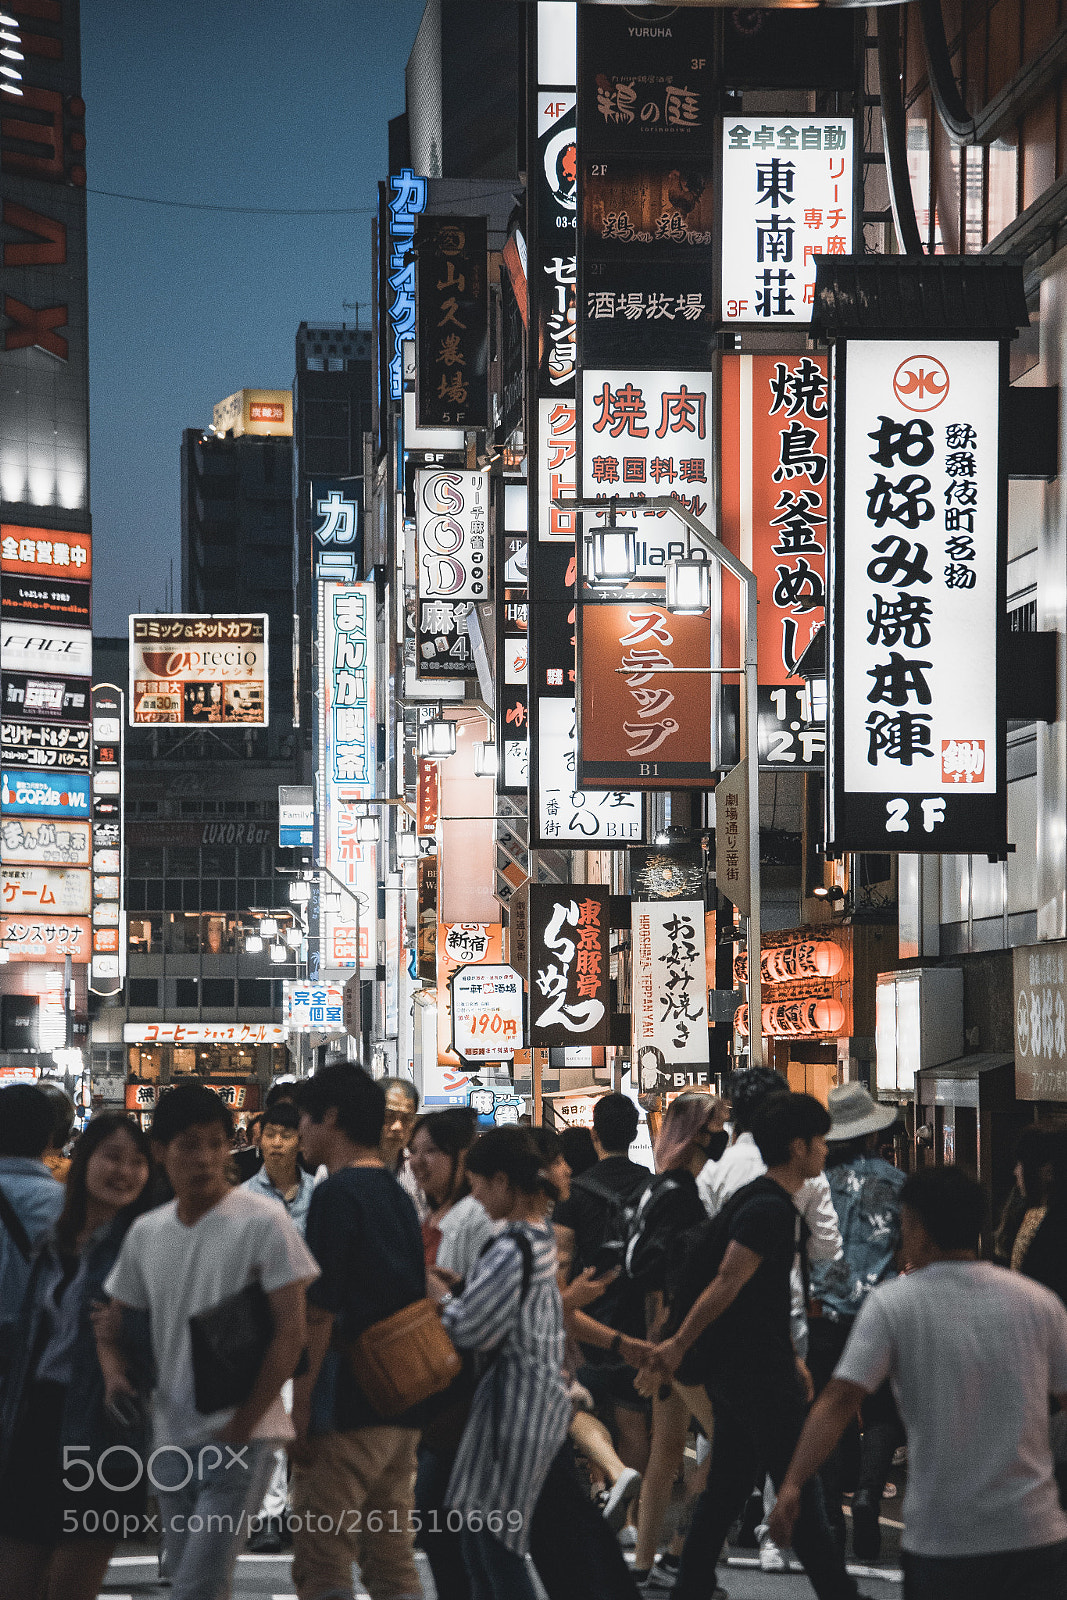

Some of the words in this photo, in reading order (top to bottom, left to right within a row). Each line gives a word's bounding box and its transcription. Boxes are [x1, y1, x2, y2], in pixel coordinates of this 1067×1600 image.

[628, 27, 672, 37] YURUHA
[691, 58, 706, 70] 3F
[544, 102, 566, 118] 4F
[728, 124, 847, 150] 全卓全自動
[591, 164, 608, 176] 2F
[755, 157, 796, 318] 東南荘
[587, 292, 706, 321] 酒場牧場
[726, 300, 748, 318] 3F
[441, 412, 467, 424] 5F
[591, 381, 706, 440] 焼肉
[547, 403, 576, 536] クアトロ
[592, 456, 707, 485] 韓国料理
[768, 357, 827, 678] 焼鳥釜めし
[943, 423, 978, 591] 歌舞伎町名物
[1, 536, 87, 568] 全店営業中
[866, 415, 935, 768] お好み焼本陣
[135, 621, 263, 638] コミック&ネットカフェ
[3, 635, 88, 655] FACE
[196, 668, 255, 676] アプレシオ
[136, 681, 181, 693] 新宿最大
[333, 592, 368, 784] まんが喫茶
[618, 611, 680, 757] ステップ
[1, 724, 89, 749] ビリヤード&ダーツ
[27, 748, 57, 765] ゴルフ
[638, 763, 661, 776] B1
[544, 787, 561, 837] 一番街
[885, 797, 948, 833] 2F
[2, 821, 87, 852] まんが喫茶
[606, 823, 639, 837] B1F
[724, 792, 740, 882] 劇場通り一番街
[3, 883, 57, 905] ゲーム
[6, 924, 84, 943] メンズサウナ
[447, 930, 487, 953] 新宿
[460, 951, 474, 961] の
[575, 897, 602, 999] 東京豚骨
[657, 912, 703, 1049] お好み焼き
[294, 991, 327, 1006] 完全
[308, 1007, 342, 1022] 個室
[471, 1013, 517, 1035] 190円
[143, 1026, 199, 1041] コーヒー
[240, 1026, 268, 1041] クール
[672, 1072, 708, 1088] B1F
